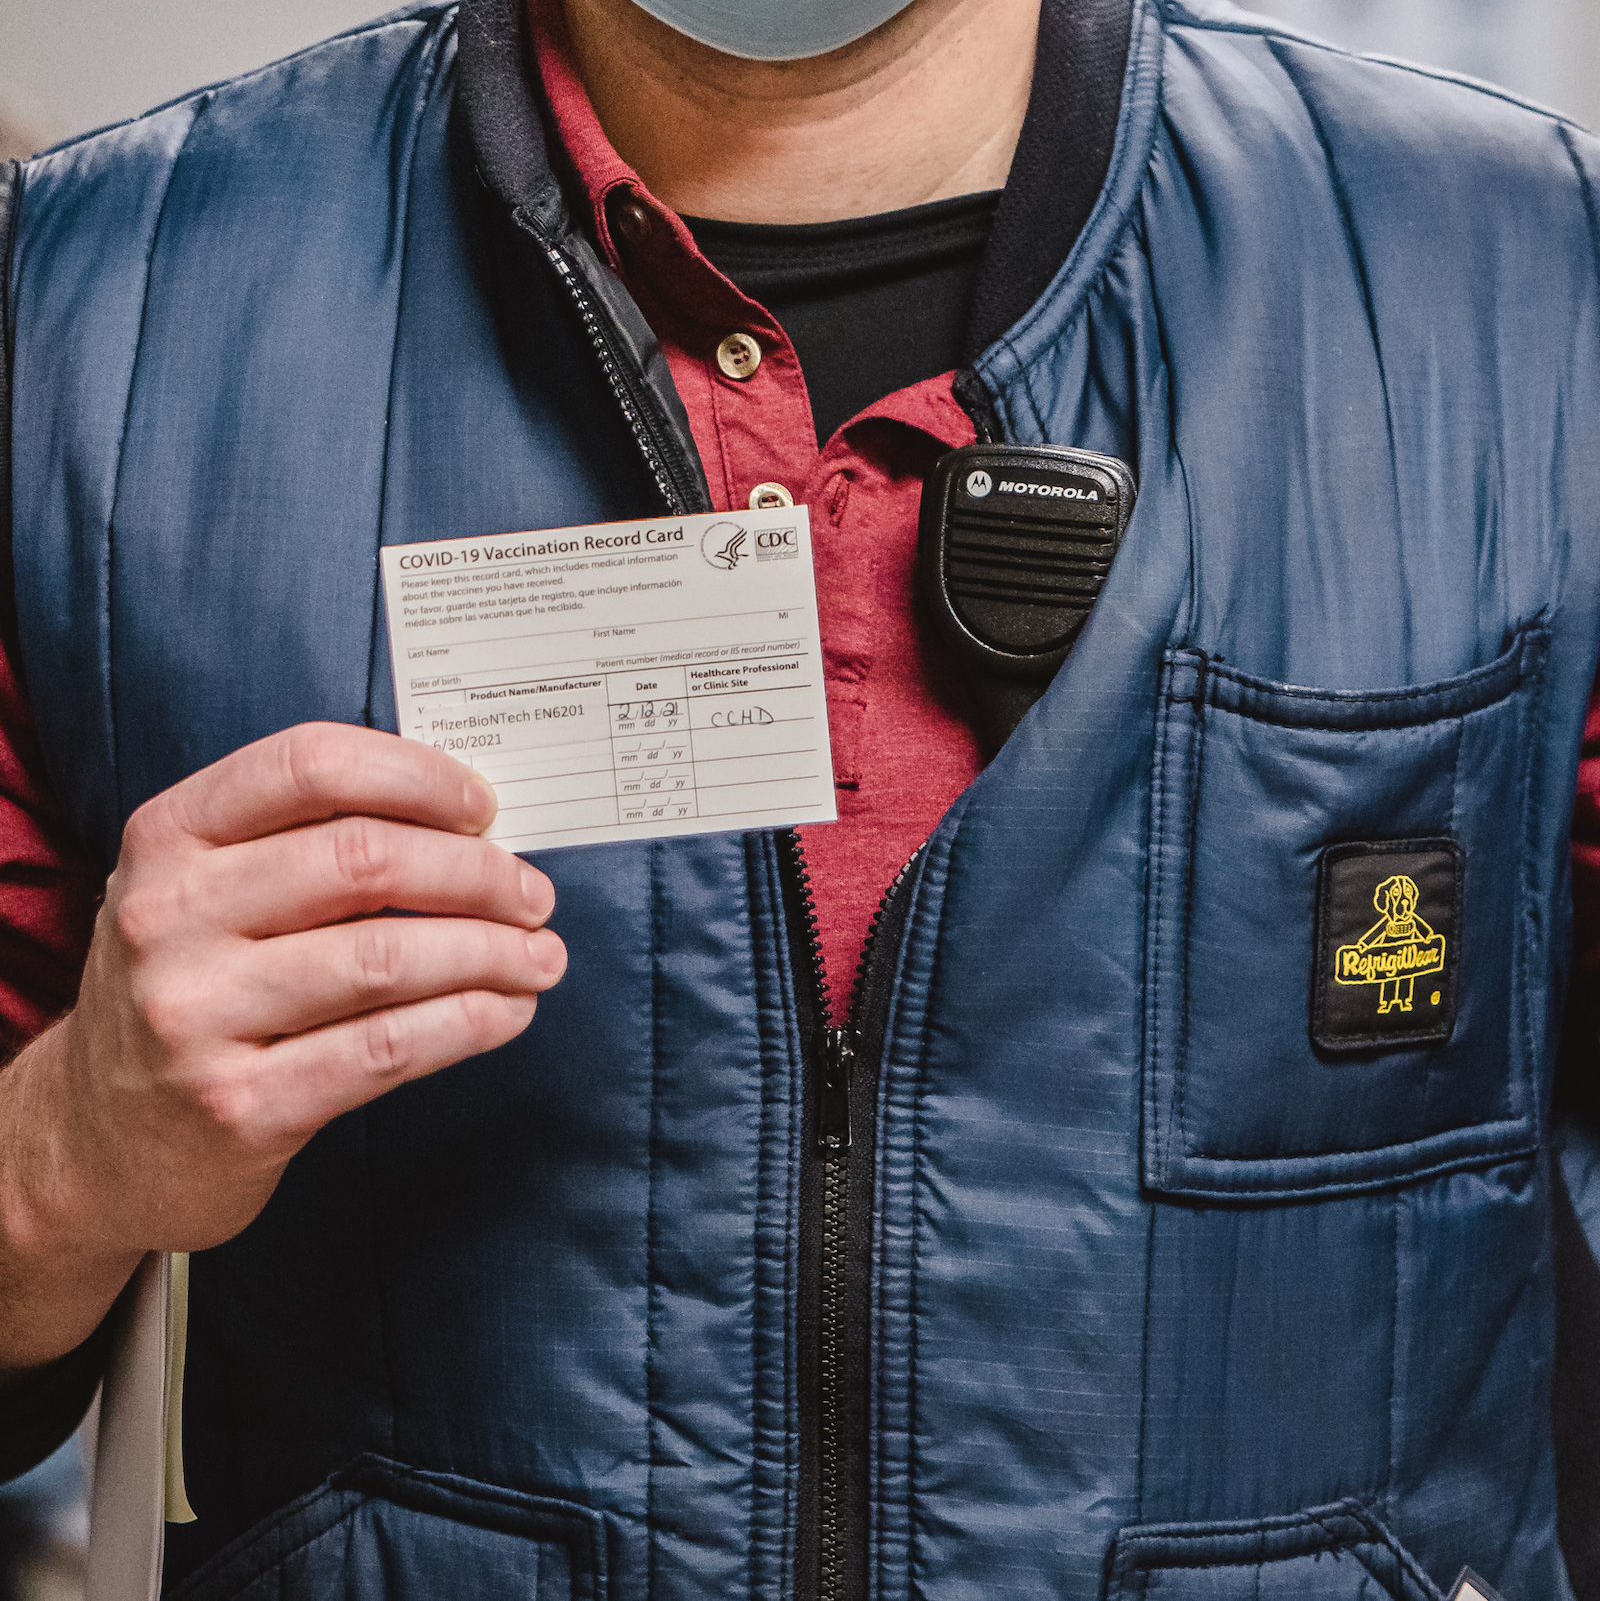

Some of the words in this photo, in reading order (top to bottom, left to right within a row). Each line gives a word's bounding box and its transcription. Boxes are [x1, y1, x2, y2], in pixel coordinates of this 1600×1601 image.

[999, 481, 1099, 500] MOTOROLA
[400, 549, 480, 570] COVID-19
[484, 540, 579, 561] Vaccination
[585, 531, 641, 550] Record
[646, 526, 684, 543] Card
[757, 530, 795, 548] CDC
[401, 579, 429, 589] Please
[431, 577, 451, 587] keep
[454, 574, 470, 583] this
[472, 569, 500, 581] record
[525, 565, 551, 576] which
[553, 561, 589, 573] includes
[591, 557, 625, 568] medical
[627, 553, 679, 566] information
[403, 591, 428, 601] about
[430, 589, 445, 598] the
[447, 585, 483, 597] vaccines
[485, 584, 502, 595] you
[504, 581, 524, 591] have
[526, 576, 566, 588] received.
[404, 606, 418, 616] Por
[446, 600, 476, 613] guarde
[479, 599, 497, 608] esta
[498, 595, 527, 607] tarjeta
[528, 592, 540, 602] de
[541, 589, 577, 602] registro,
[578, 588, 596, 599] que
[597, 583, 629, 596] incluye
[630, 579, 683, 592] información
[405, 616, 437, 628] médica
[439, 612, 463, 624] sobre
[465, 611, 477, 621] las
[479, 610, 514, 621] vacunas
[516, 608, 533, 619] que
[534, 604, 546, 614] ha
[547, 602, 585, 613] recibido.
[778, 611, 789, 619] MI
[593, 630, 610, 638] First
[612, 627, 636, 636] Name
[408, 650, 425, 659] Last
[426, 647, 450, 657] Name
[596, 658, 625, 668] Patient
[626, 655, 658, 665] number
[660, 652, 694, 663] (medical
[694, 648, 720, 658] record
[740, 643, 766, 653] record
[767, 641, 801, 651] number)
[690, 667, 741, 679] Healthcare
[742, 661, 800, 675] Professional
[410, 681, 430, 689] Date
[432, 678, 441, 687] of
[442, 676, 462, 686] birth
[470, 690, 507, 701] Product
[509, 679, 602, 697] Name/Manufacturer
[636, 681, 658, 691] Date
[692, 684, 702, 692] or
[704, 681, 730, 691] Clinic
[731, 678, 749, 688] Site
[432, 708, 531, 732] PfizerBioNTech
[535, 704, 585, 721] EN6201
[618, 723, 636, 731] mm
[644, 719, 656, 727] dd
[668, 719, 678, 727] yy
[711, 706, 775, 727] CCHD
[647, 751, 659, 760] dd
[672, 750, 683, 759] yy
[624, 783, 641, 791] mm
[650, 780, 662, 789] dd
[676, 779, 686, 789] yy
[626, 811, 644, 819] mm
[652, 807, 664, 816] dd
[678, 807, 688, 816] yy
[1343, 944, 1440, 981] RefrigiWear
